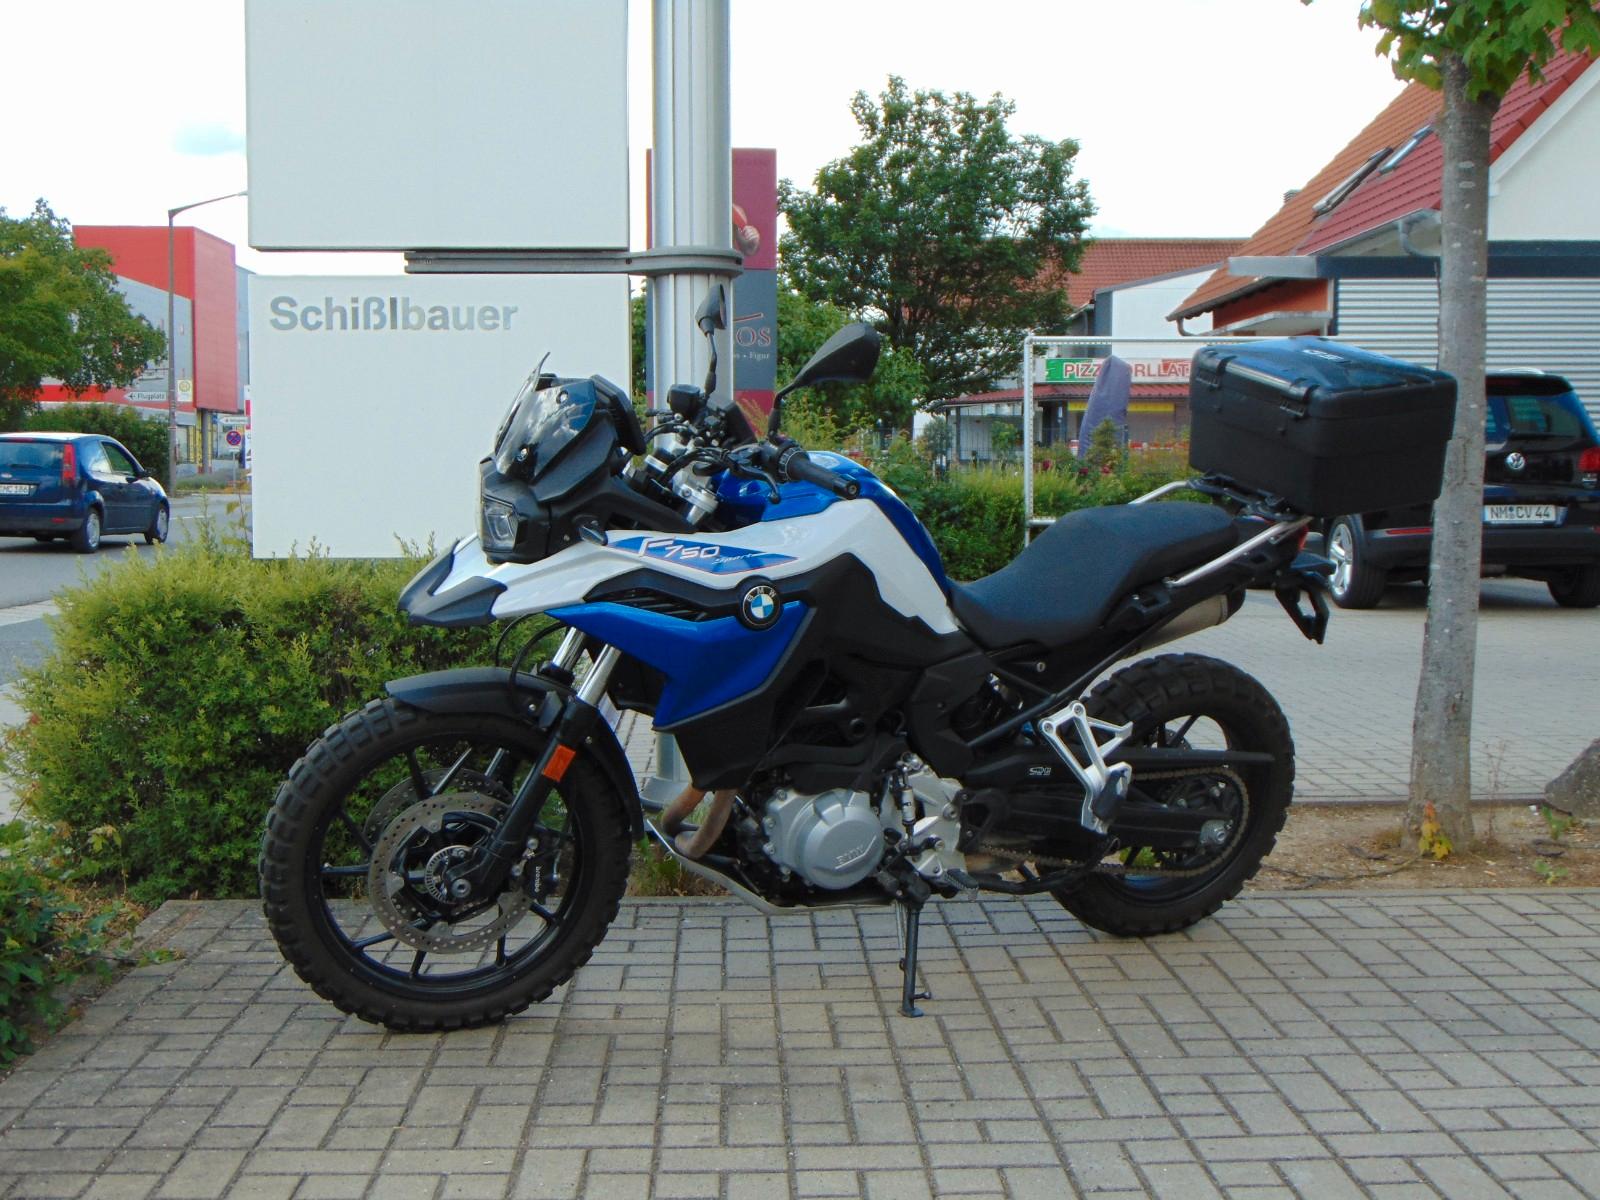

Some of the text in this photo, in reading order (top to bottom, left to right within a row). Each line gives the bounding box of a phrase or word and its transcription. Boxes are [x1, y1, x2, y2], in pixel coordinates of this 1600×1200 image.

[269, 295, 518, 331] Schißlbauer
[735, 326, 771, 347] OS
[1064, 363, 1104, 377] PIZZ
[137, 392, 165, 400] Flugplatz
[1490, 506, 1508, 519] NM
[1535, 506, 1550, 518] 44
